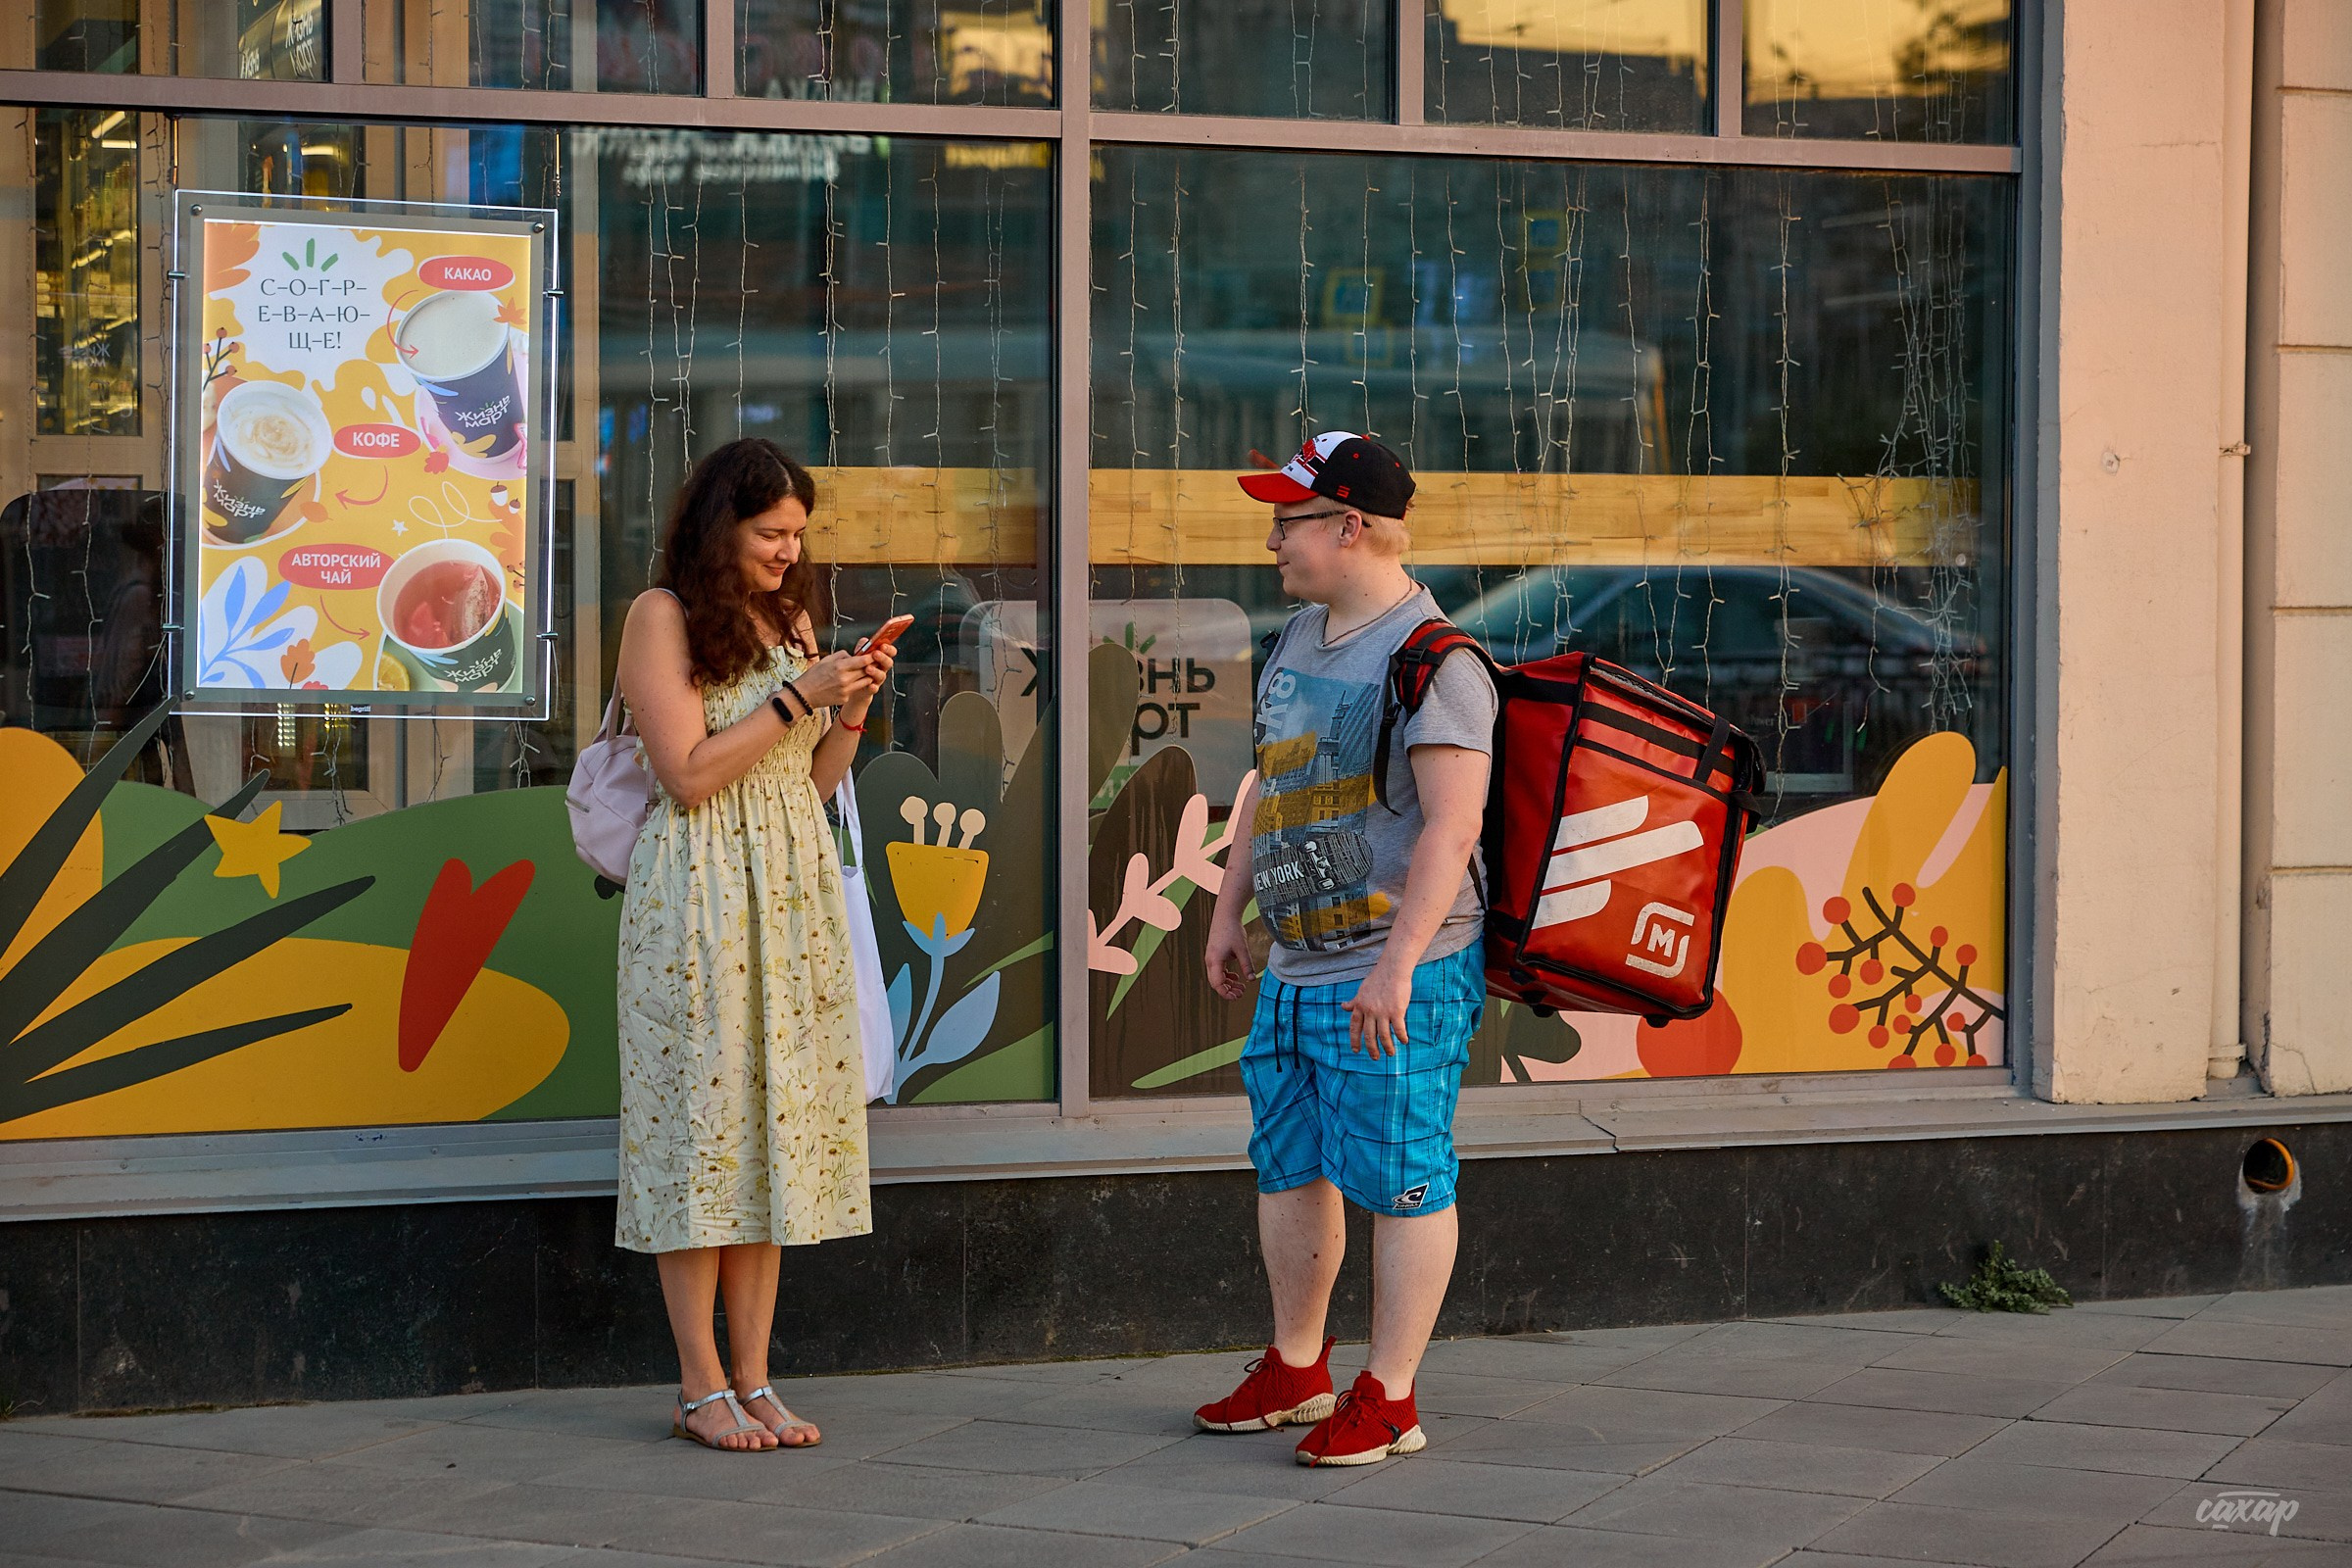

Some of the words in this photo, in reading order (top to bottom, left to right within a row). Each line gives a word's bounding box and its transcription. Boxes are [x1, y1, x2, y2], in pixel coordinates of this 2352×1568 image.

[445, 268, 491, 280] КАКАО
[353, 431, 400, 448] КОФЕ
[292, 553, 381, 568] АВТОРСКИЙ
[321, 569, 351, 583] ЧАЙ
[1131, 702, 1200, 757] рт
[1270, 860, 1304, 886] YORK
